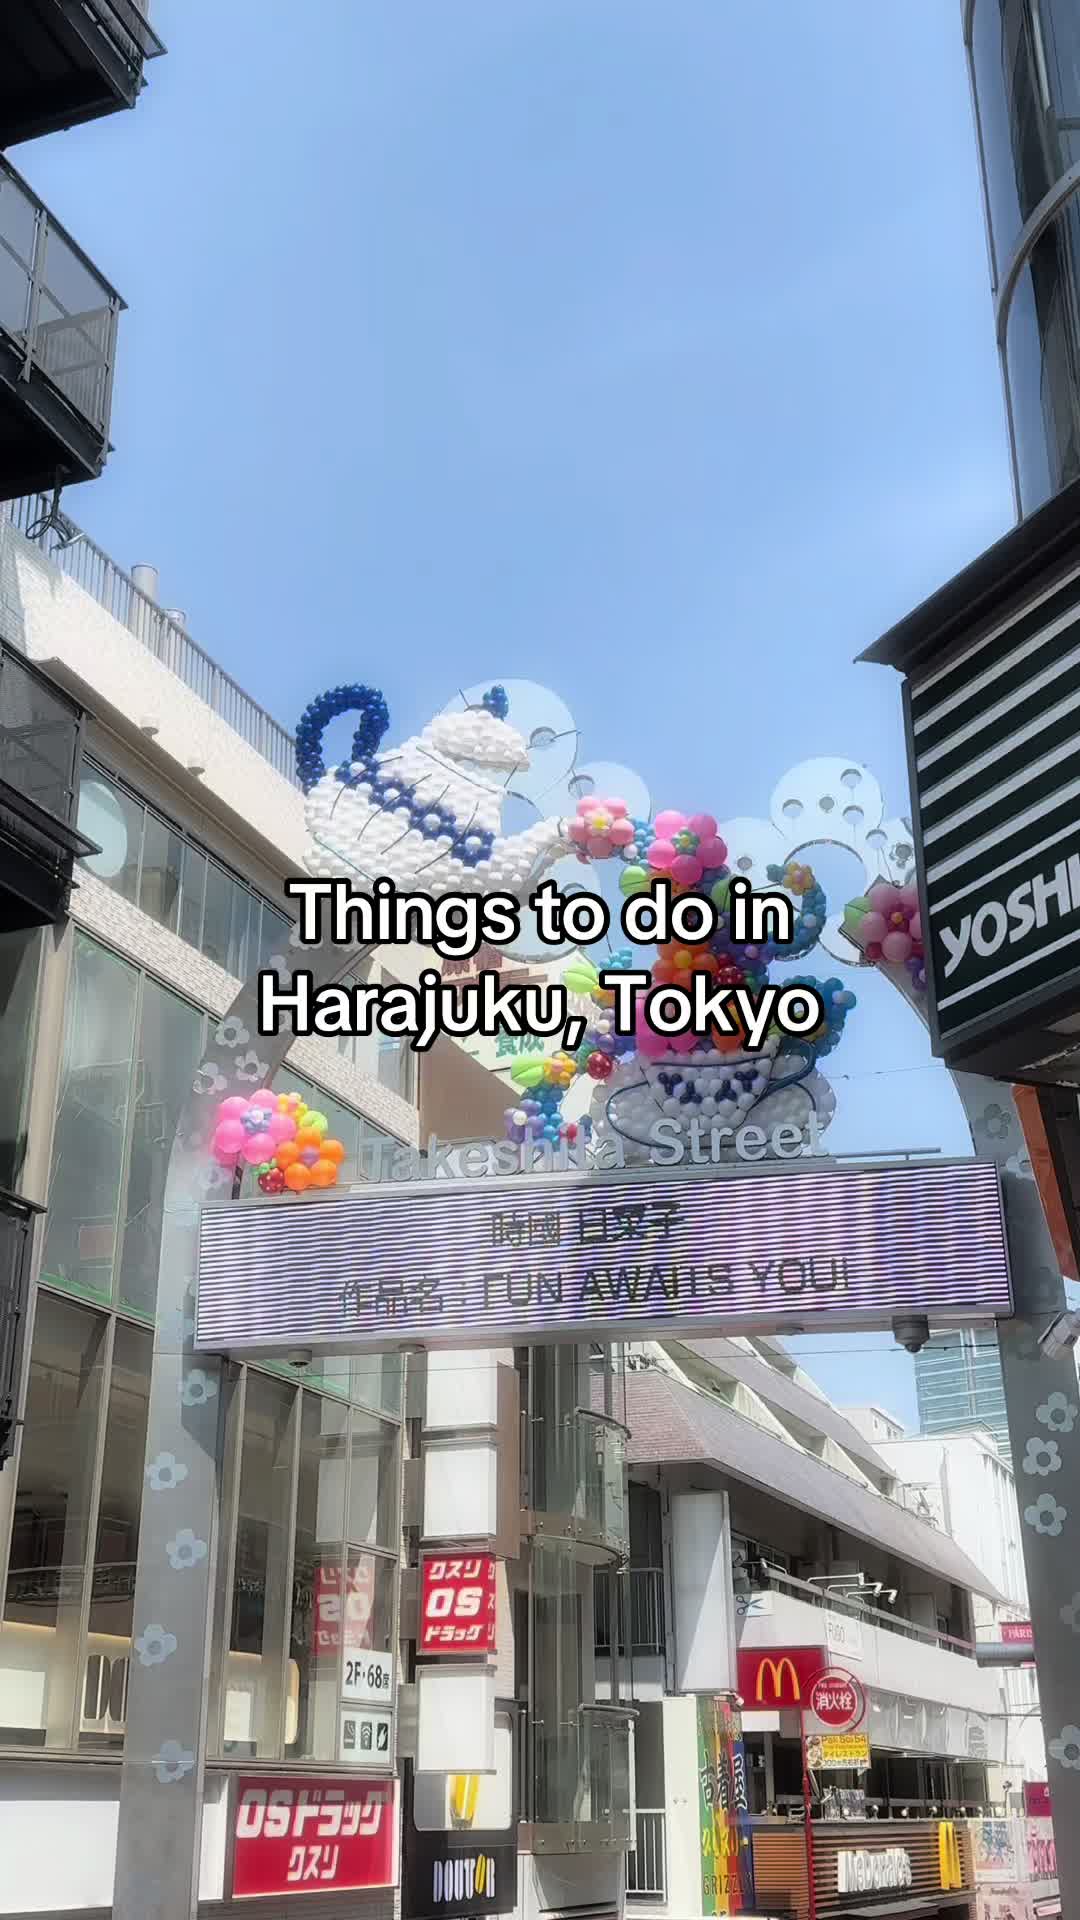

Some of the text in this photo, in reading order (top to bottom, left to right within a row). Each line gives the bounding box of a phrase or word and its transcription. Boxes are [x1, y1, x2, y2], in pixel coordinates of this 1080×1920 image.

[938, 853, 1080, 978] YOSHI
[360, 1111, 828, 1183] Takeshita Street
[579, 1261, 735, 1302] AWAITS
[428, 1559, 482, 1581] クスリ
[425, 1586, 483, 1618] OS
[815, 1690, 853, 1711] 消火栓
[286, 1844, 340, 1882] クスリ
[433, 1854, 495, 1903] DOUTOR
